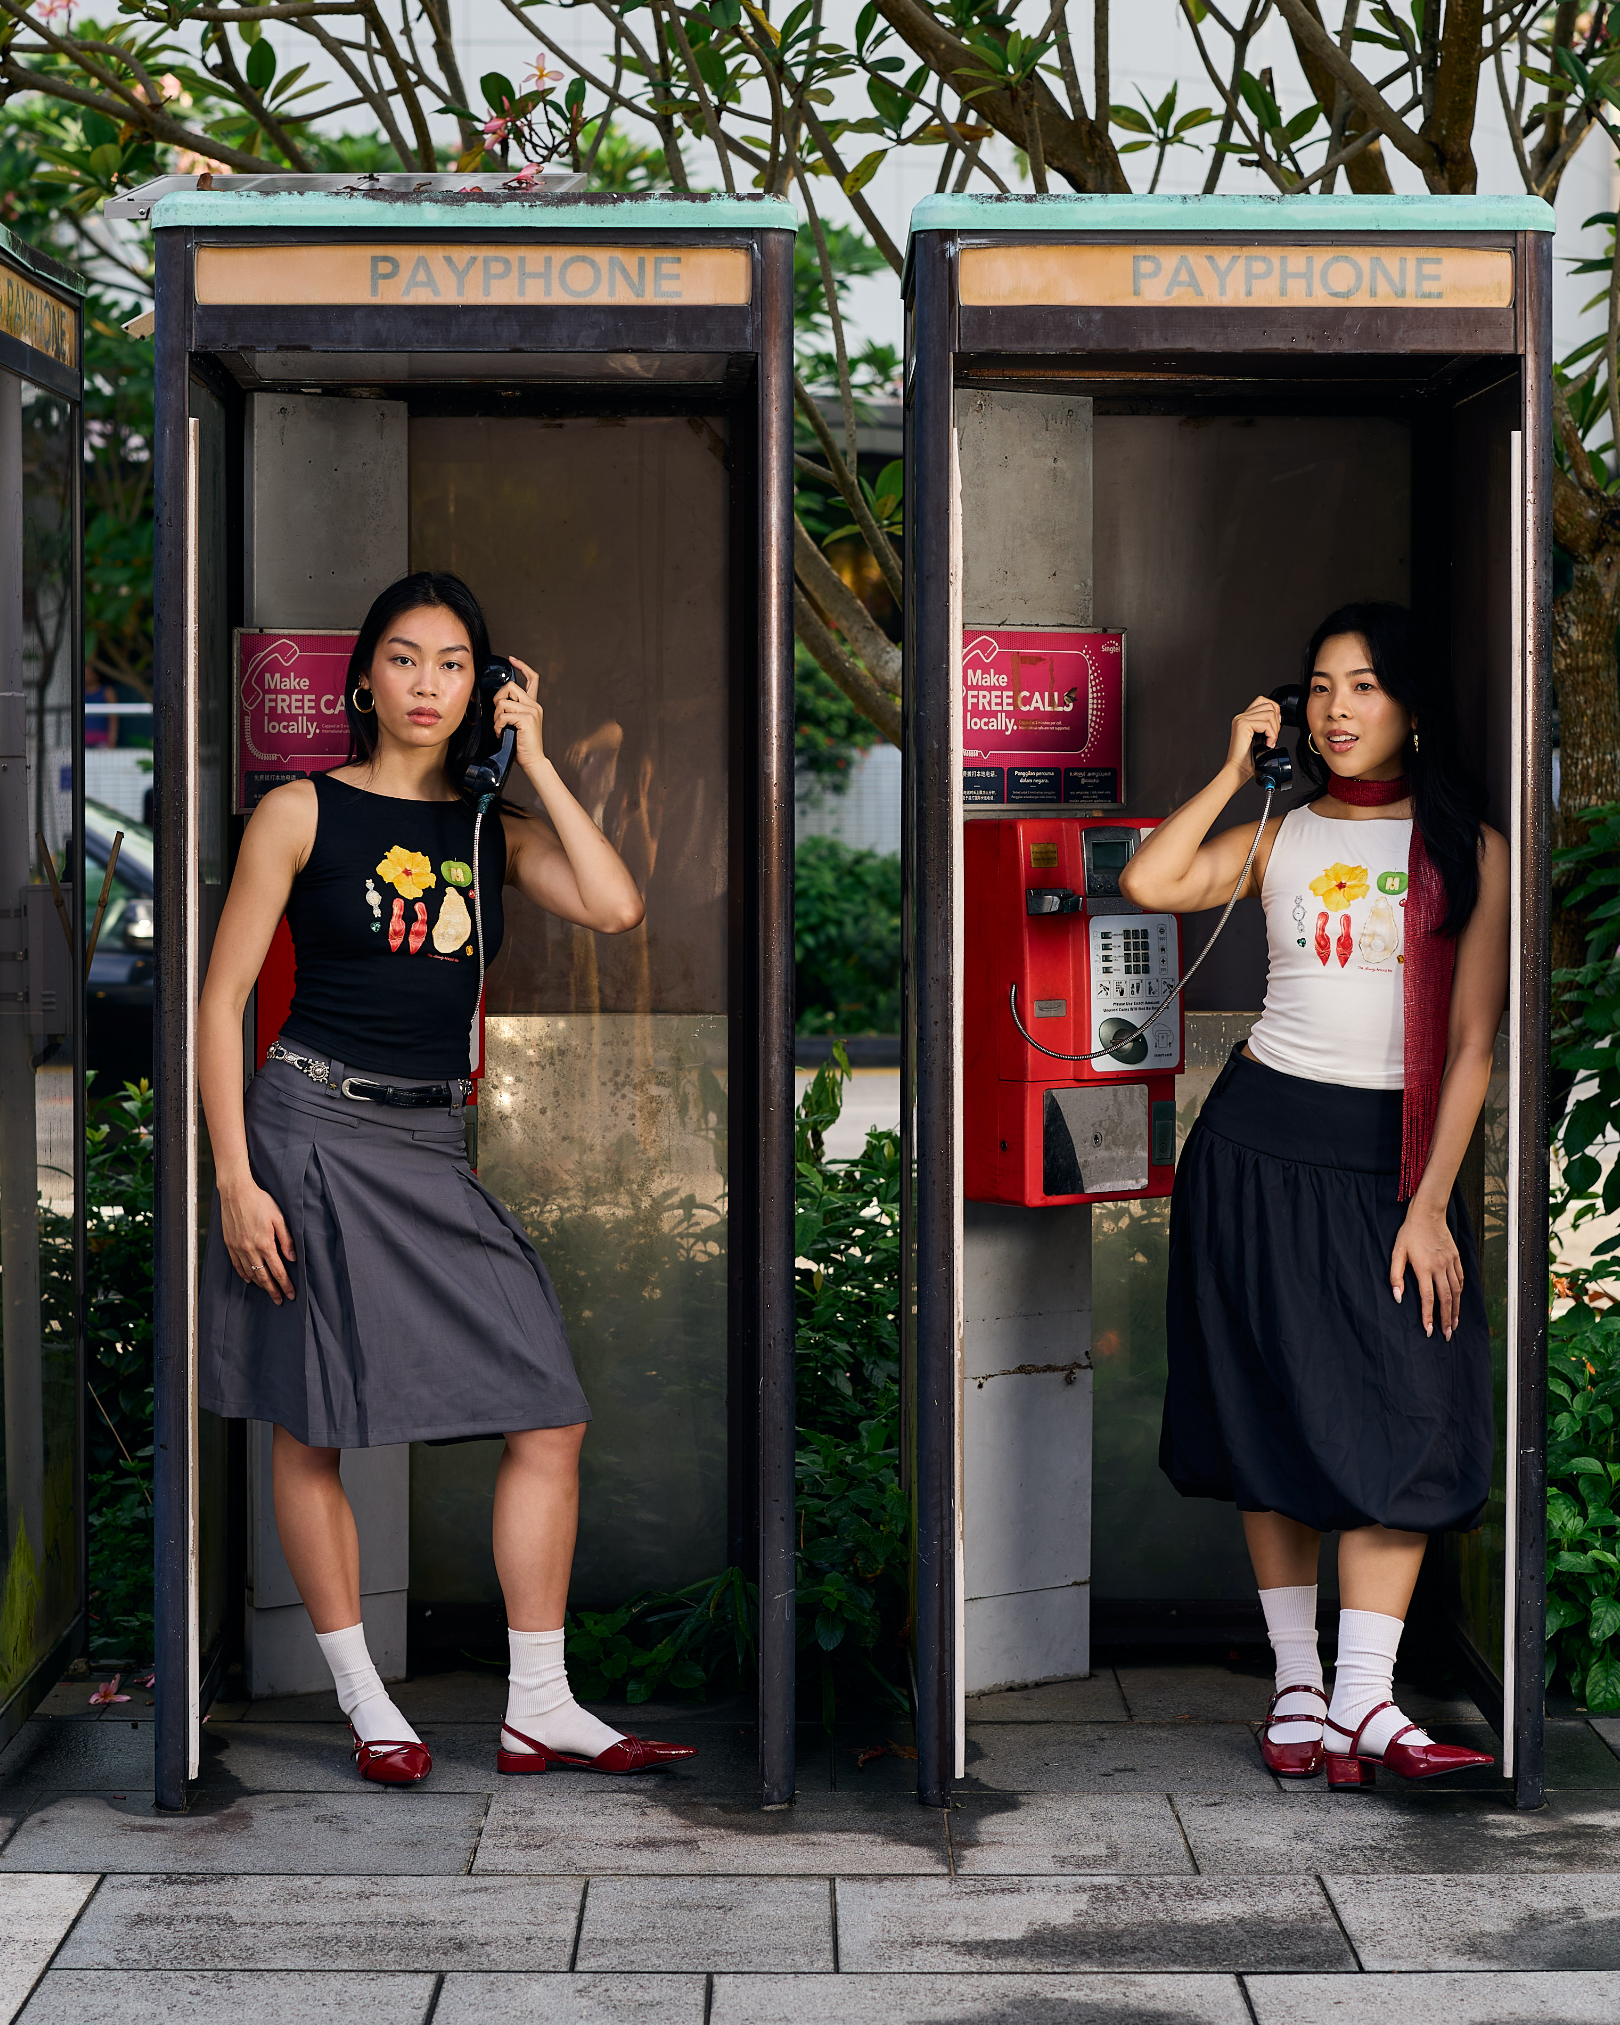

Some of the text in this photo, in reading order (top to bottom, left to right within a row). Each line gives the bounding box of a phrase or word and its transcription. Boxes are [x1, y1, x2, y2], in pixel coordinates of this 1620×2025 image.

[370, 255, 682, 298] PAYPHONE
[1132, 255, 1444, 300] PAYPHONE
[7, 278, 66, 363] PAYPHONE
[1101, 644, 1121, 654] Singtel
[264, 673, 310, 690] Make
[967, 669, 1008, 687] Make
[264, 694, 346, 715] FREE CA
[967, 691, 1074, 711] FREE CALLS
[264, 716, 320, 739] locally.
[967, 712, 1018, 735] locally.
